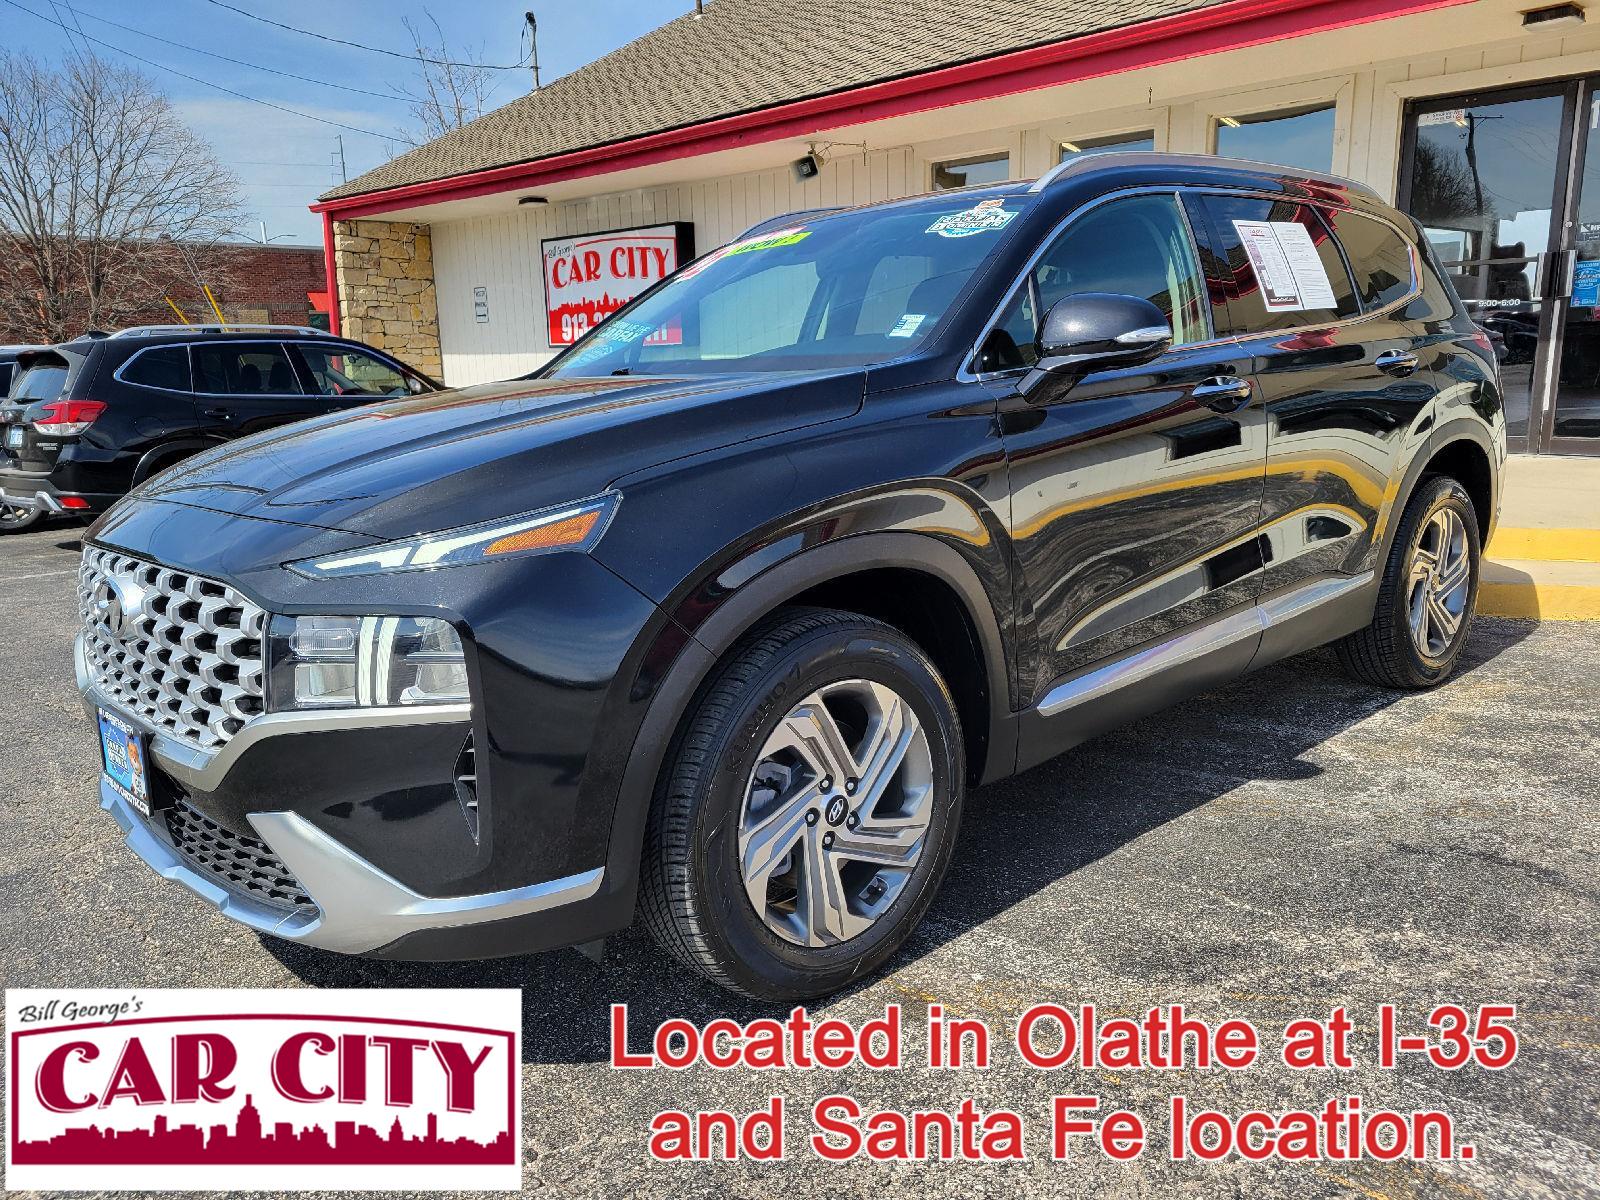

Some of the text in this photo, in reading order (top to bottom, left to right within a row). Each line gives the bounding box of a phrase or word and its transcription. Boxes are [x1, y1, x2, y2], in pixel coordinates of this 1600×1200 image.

[551, 250, 602, 289] CAR
[610, 246, 670, 280] CITY
[1478, 298, 1521, 307] 9:00-6:00
